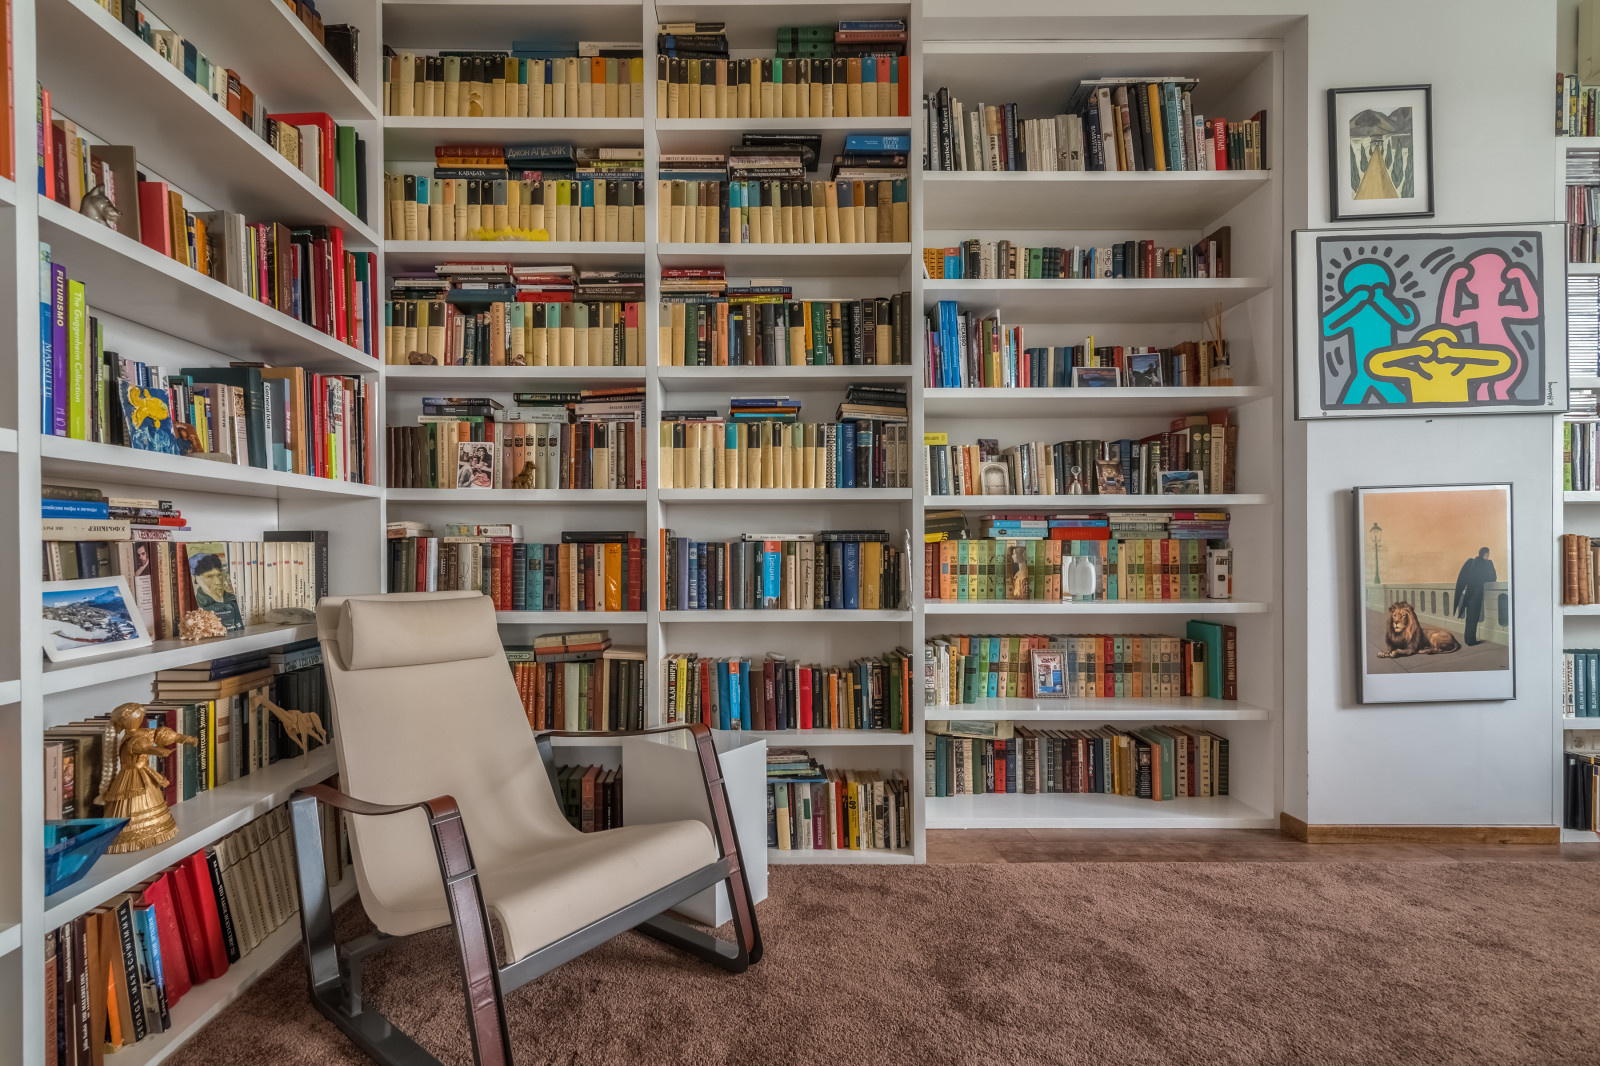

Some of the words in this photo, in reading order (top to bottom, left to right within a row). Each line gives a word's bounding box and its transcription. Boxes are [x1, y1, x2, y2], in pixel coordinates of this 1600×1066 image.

[507, 148, 530, 158] Джон
[530, 146, 567, 157] АПДАЙК
[1155, 248, 1163, 267] Spain
[56, 269, 65, 327] FUTURISMO
[74, 292, 82, 307] The
[72, 309, 83, 361] Guggenheim
[825, 309, 833, 344] СЕЛИН
[74, 362, 83, 404] Collection
[1547, 381, 1558, 400] Haring
[768, 554, 776, 581] Греция
[668, 664, 676, 686] КНИГИ
[120, 908, 135, 970] SCHWIMMER
[148, 917, 156, 941] ИТАЛИЯ
[151, 942, 159, 956] МОЯ
[129, 974, 139, 994] MAX
[133, 1002, 145, 1040] GEORGE
